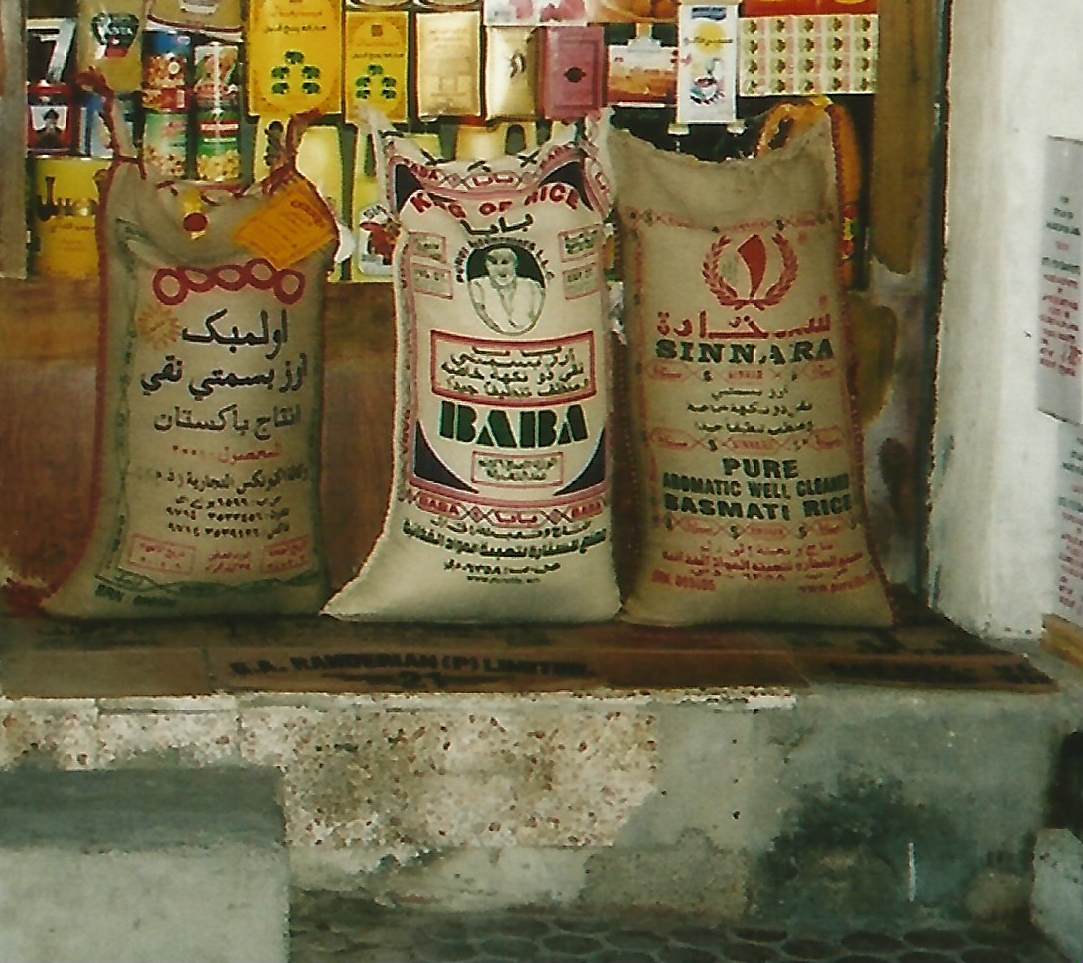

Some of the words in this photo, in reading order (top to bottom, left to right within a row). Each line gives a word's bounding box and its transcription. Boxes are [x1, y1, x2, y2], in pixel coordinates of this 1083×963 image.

[655, 338, 835, 365] SINNARA
[140, 354, 183, 396] نقي
[188, 367, 275, 401] بسمتي
[438, 400, 589, 448] BABA
[722, 457, 799, 479] PURE
[747, 481, 791, 500] WELL
[663, 492, 791, 522] BASMATI
[802, 493, 853, 518] RICE
